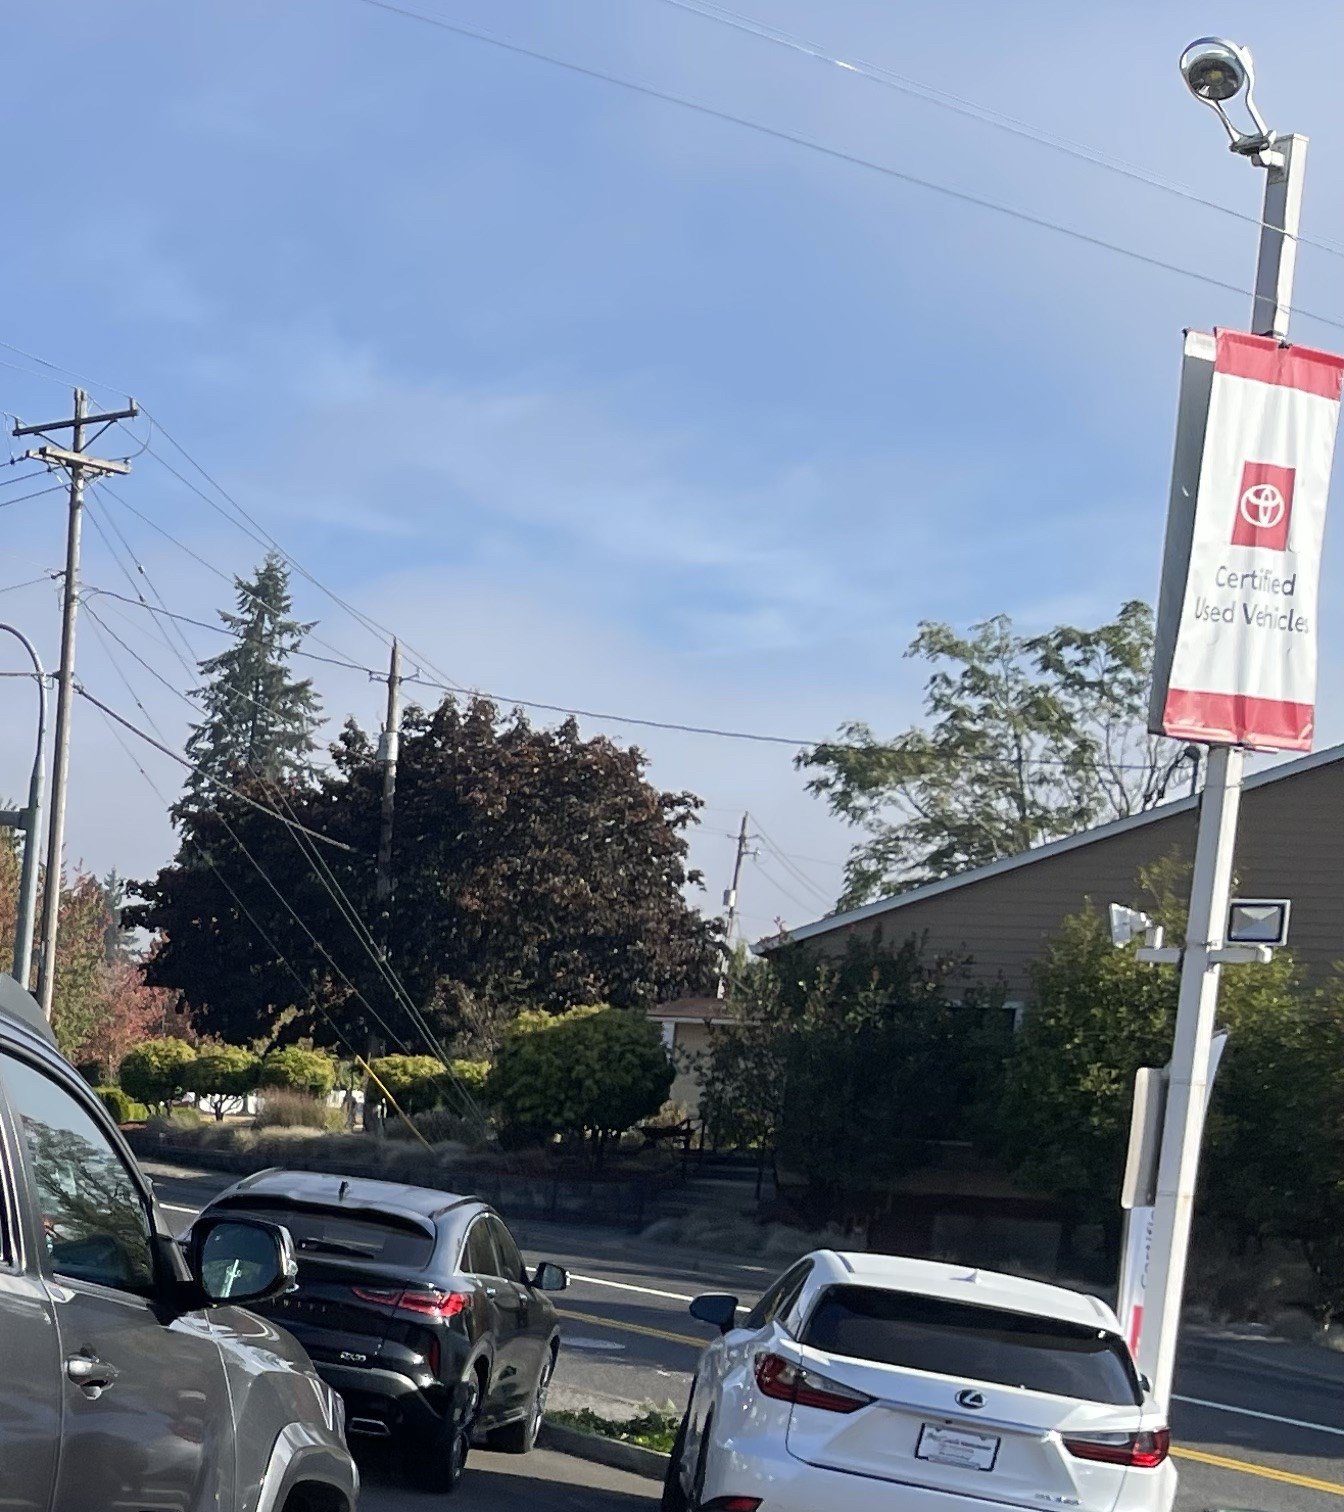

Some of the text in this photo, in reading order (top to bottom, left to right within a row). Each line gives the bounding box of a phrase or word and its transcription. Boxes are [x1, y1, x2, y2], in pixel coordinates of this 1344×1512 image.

[1215, 565, 1297, 596] Certified
[1194, 596, 1309, 633] Used Vehicles
